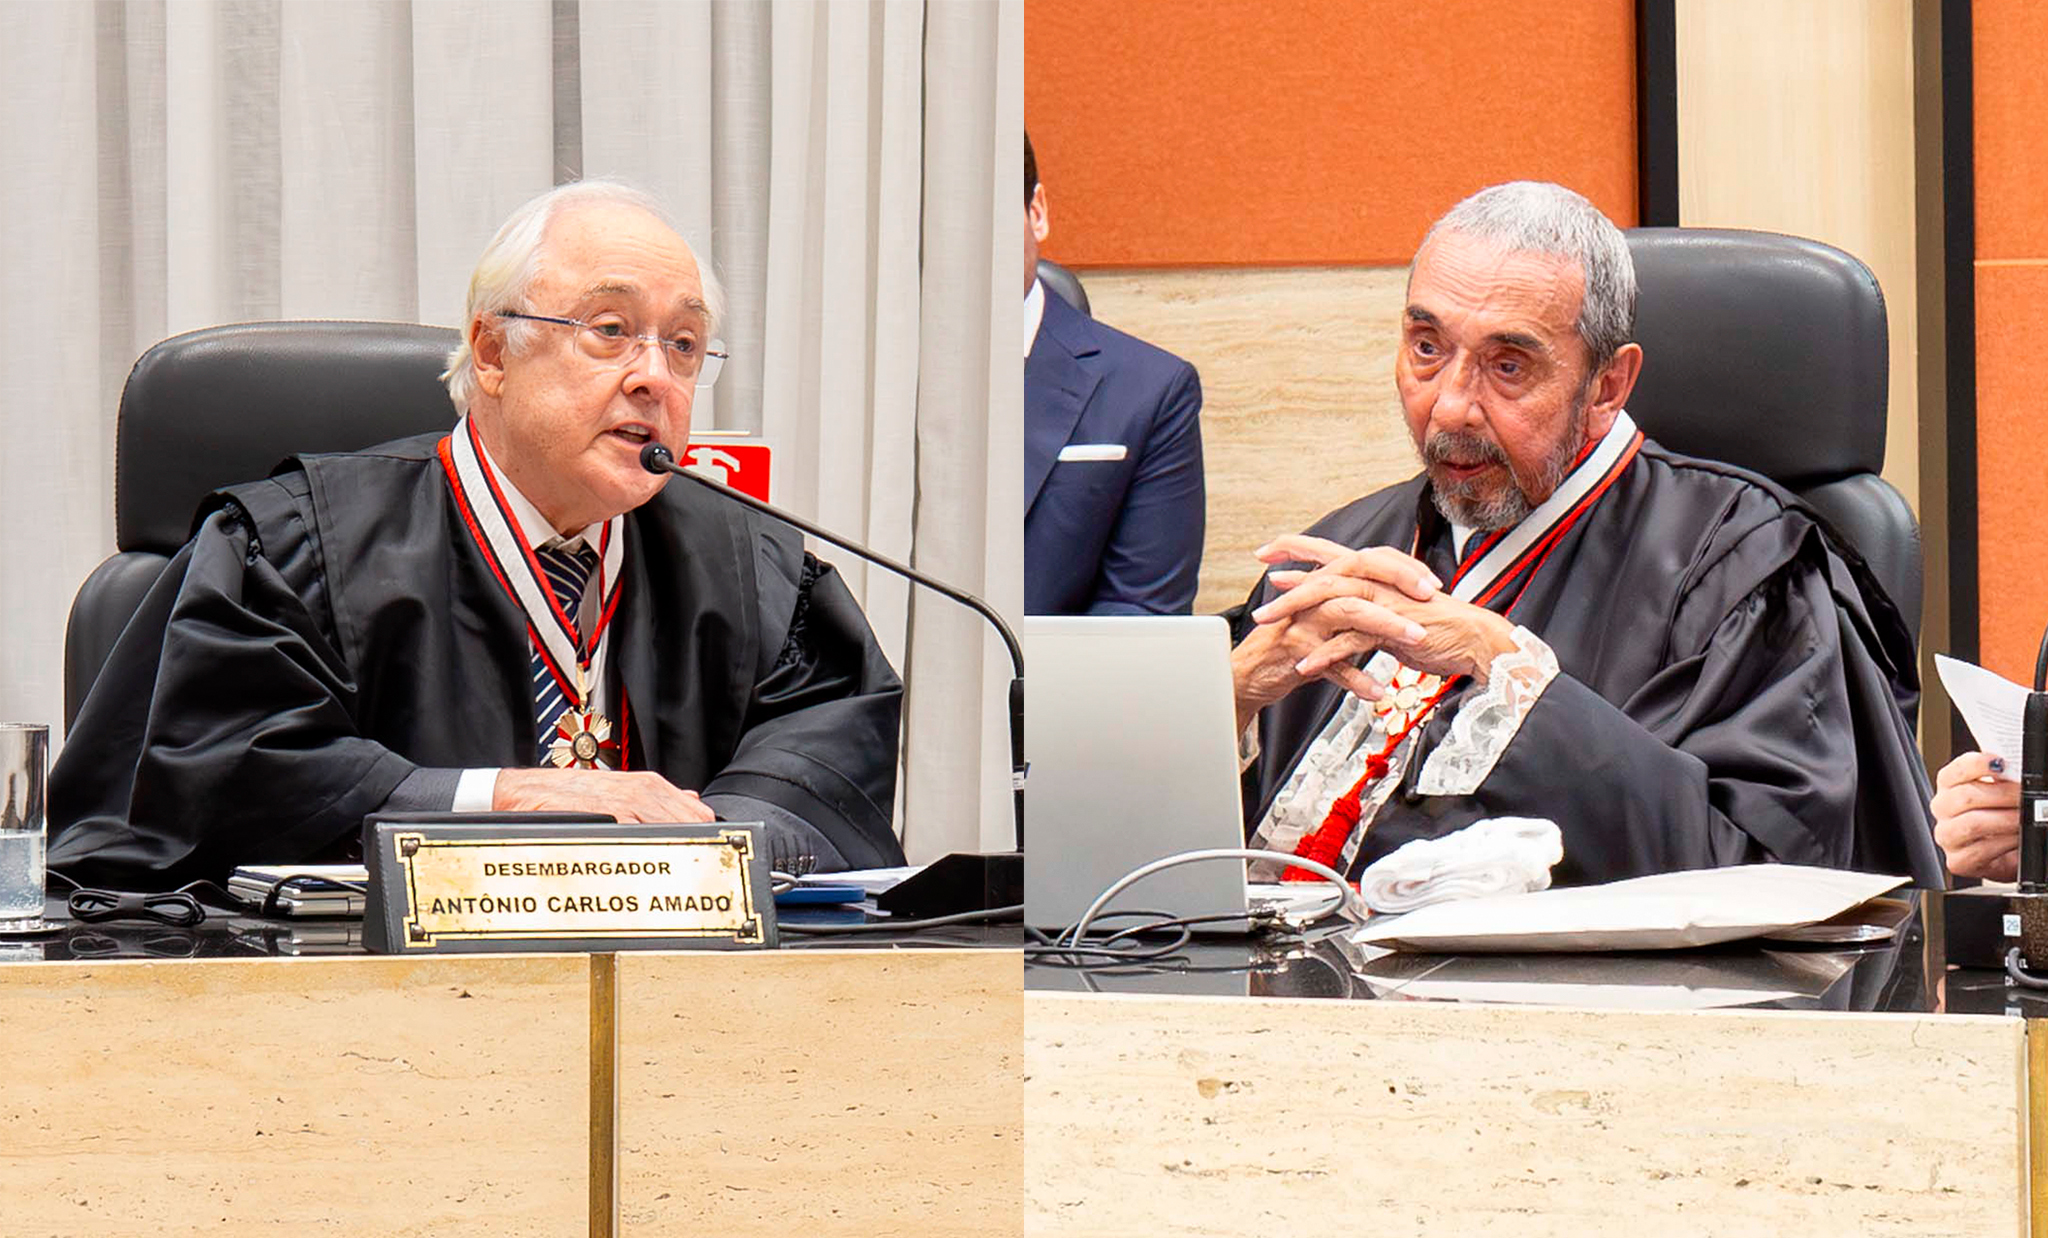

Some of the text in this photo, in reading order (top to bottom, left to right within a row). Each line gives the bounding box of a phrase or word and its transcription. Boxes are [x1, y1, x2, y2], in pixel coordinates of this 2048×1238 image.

[484, 862, 671, 876] DESEMBARGADOR
[431, 893, 731, 914] ANTÔNIO CARLOS AMADO
